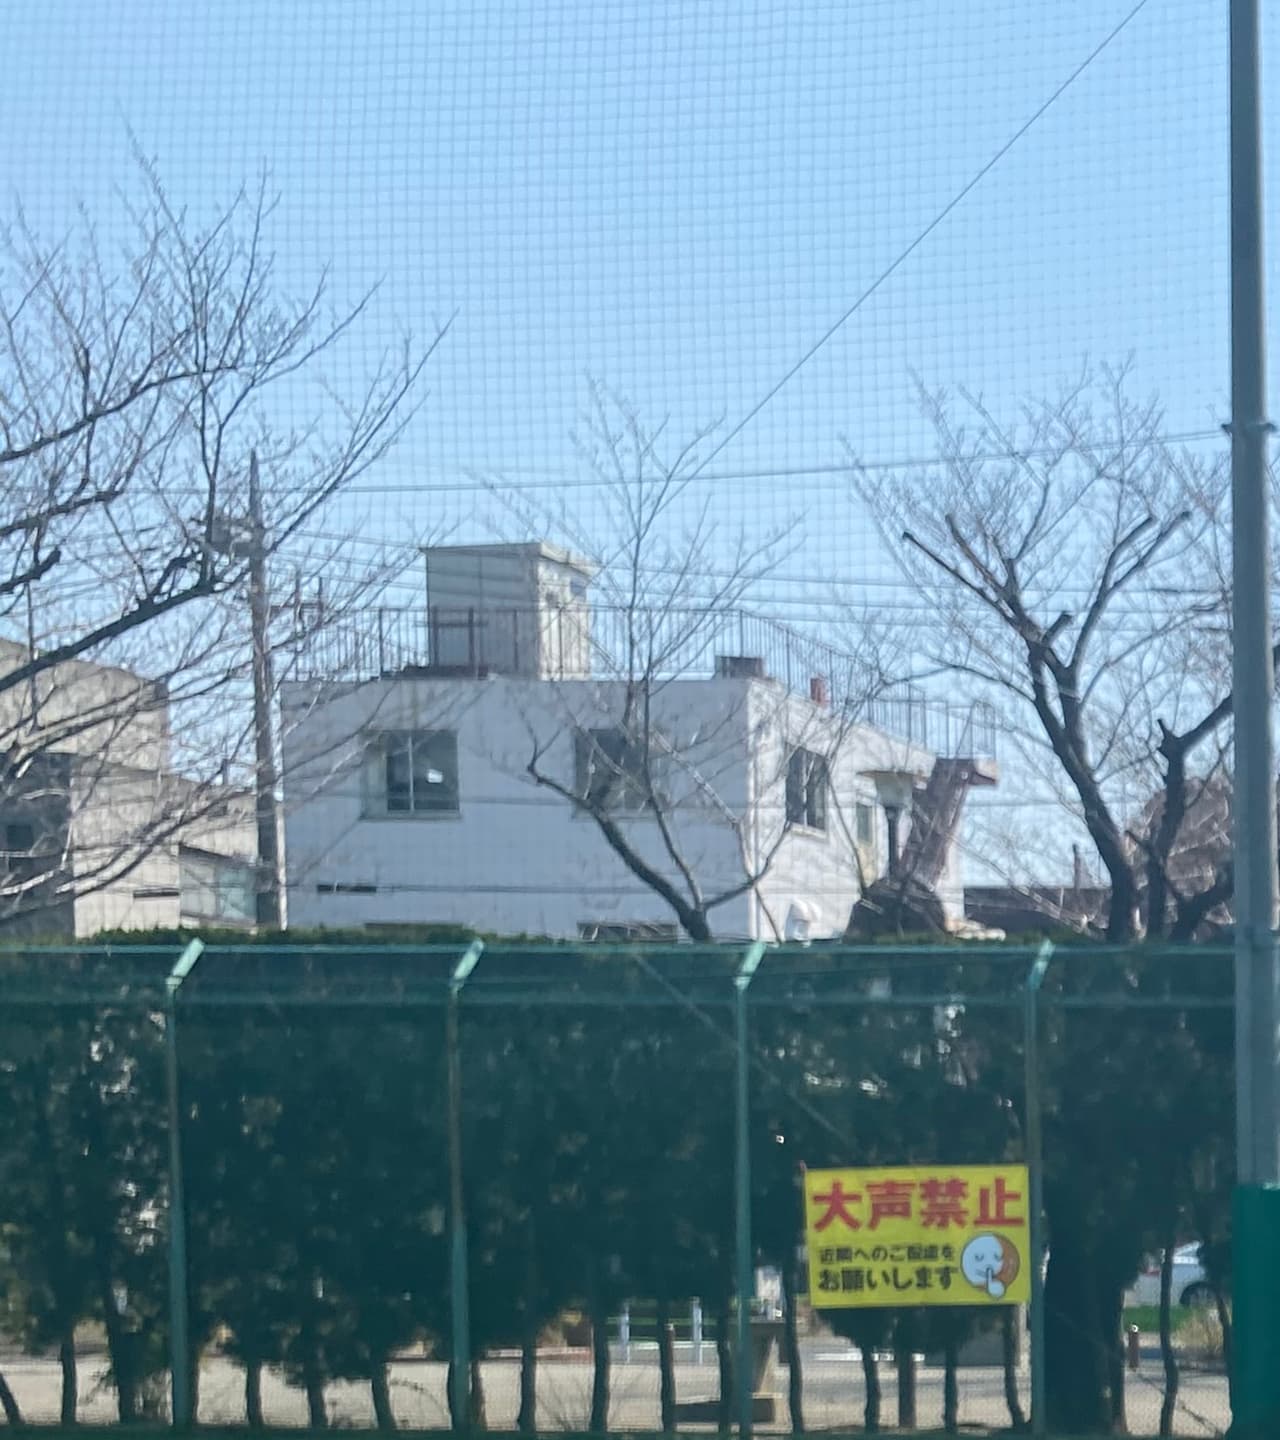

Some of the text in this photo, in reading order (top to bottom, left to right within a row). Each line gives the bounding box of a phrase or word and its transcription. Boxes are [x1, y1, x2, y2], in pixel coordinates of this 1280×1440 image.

[813, 1178, 1025, 1231] 大声禁止
[818, 1266, 959, 1292] お願いします
